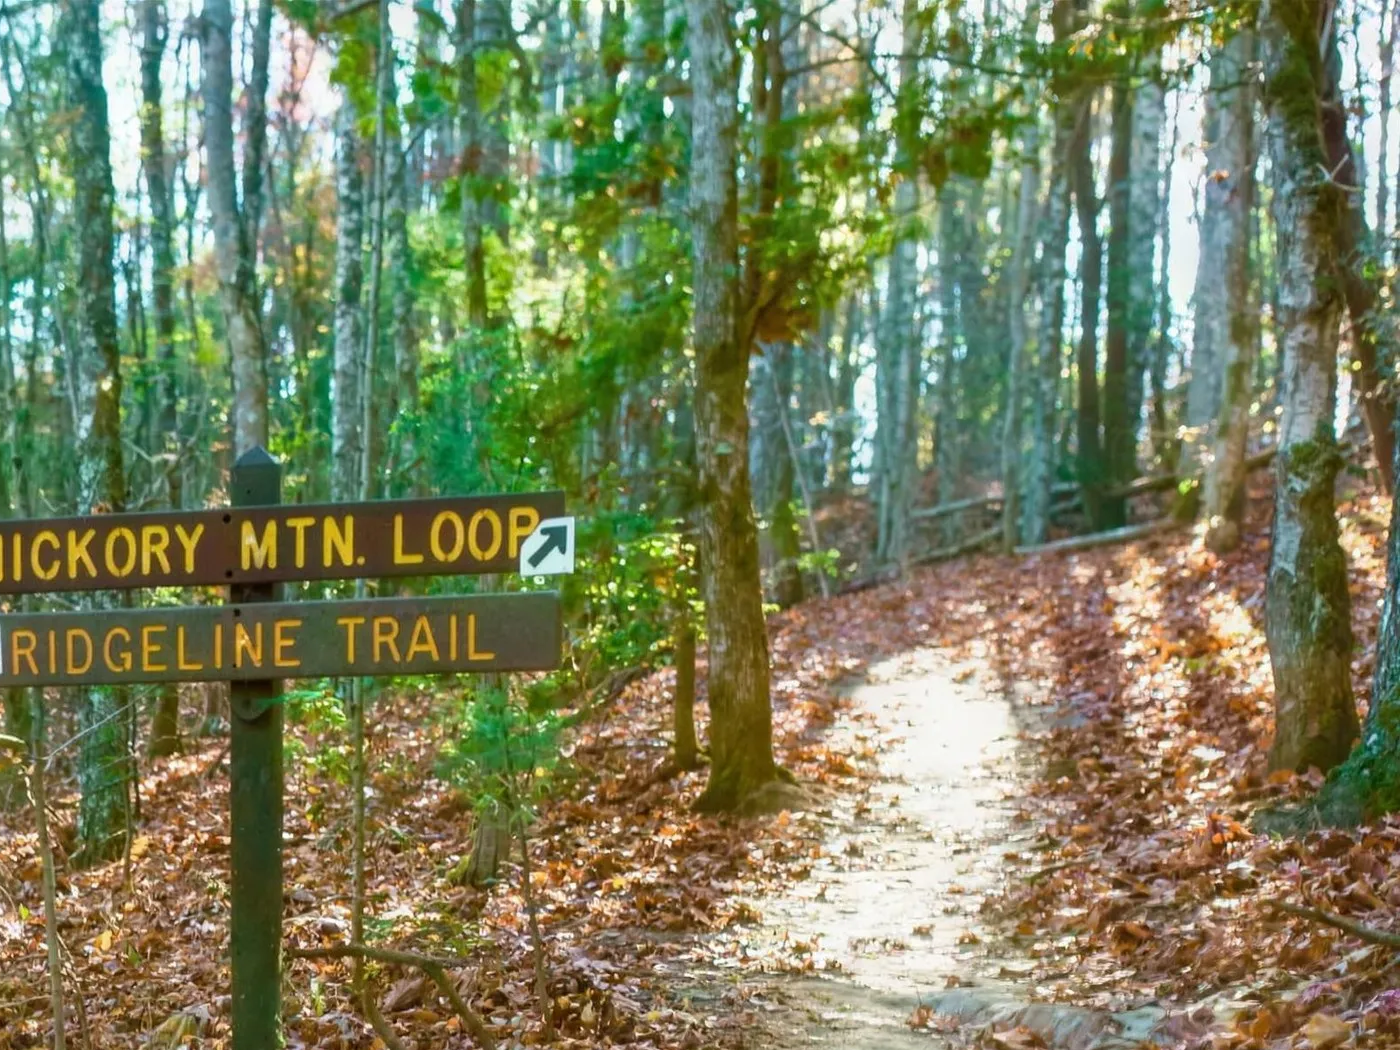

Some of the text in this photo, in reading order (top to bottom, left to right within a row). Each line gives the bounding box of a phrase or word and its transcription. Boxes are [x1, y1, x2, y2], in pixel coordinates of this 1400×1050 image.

[240, 516, 366, 570] MTN.
[394, 506, 541, 565] LOOP
[11, 613, 496, 676] RIDGELINE TRAIL
